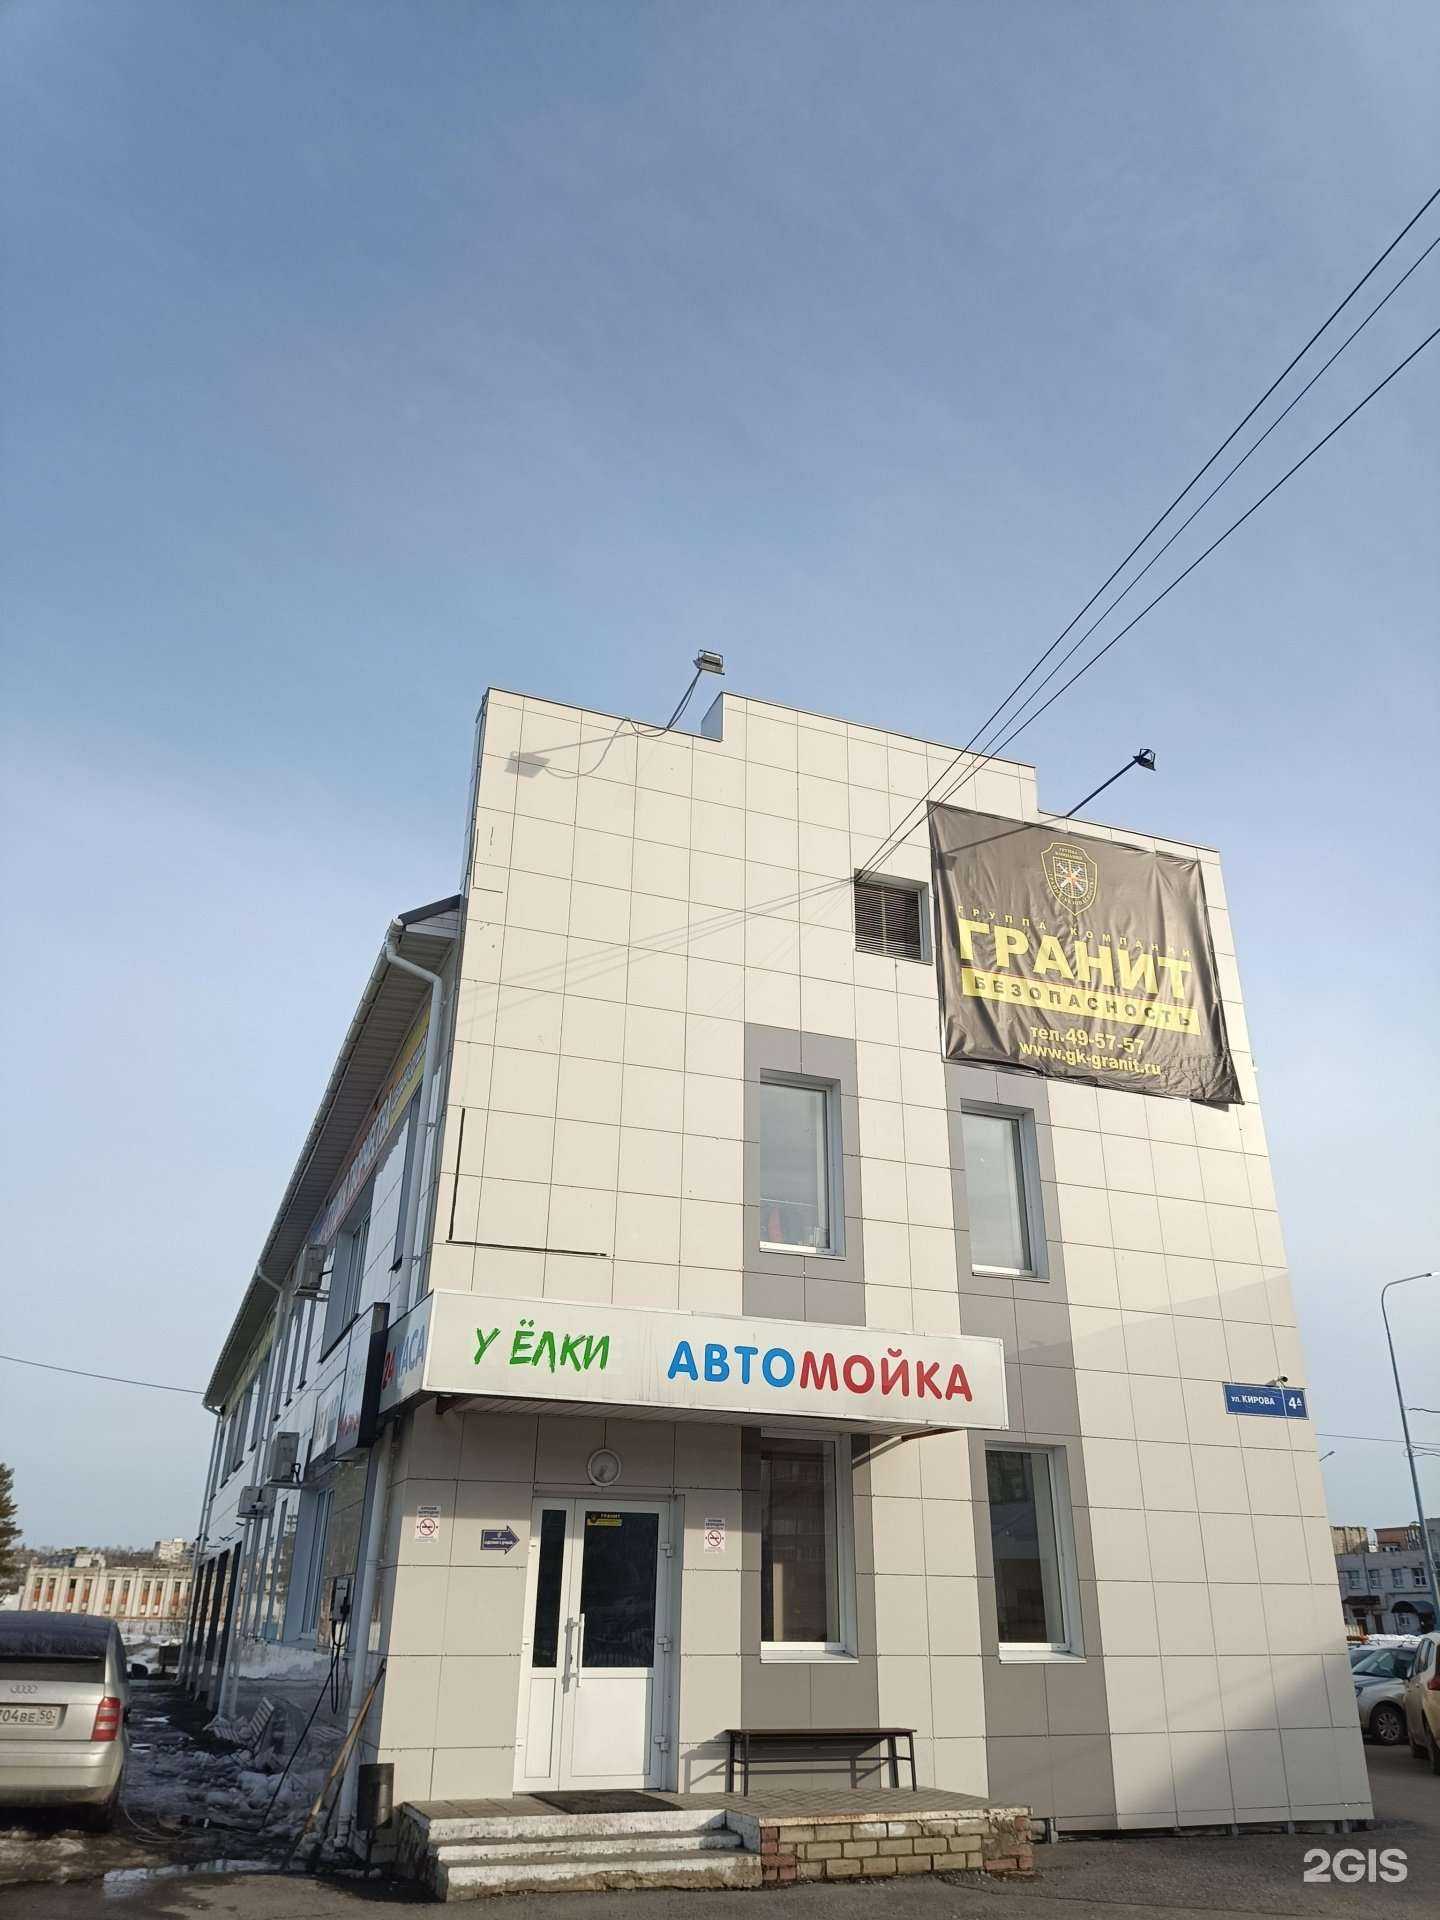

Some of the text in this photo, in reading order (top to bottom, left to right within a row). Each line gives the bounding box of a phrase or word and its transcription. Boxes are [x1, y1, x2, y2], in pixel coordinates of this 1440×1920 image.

[957, 905, 1047, 930] ГРУППА
[958, 917, 1192, 1000] ГРАНИТ
[974, 976, 1190, 1026] БЕЗОПАСНОСТЬ
[1019, 1041, 1162, 1075] www.gk-granit.ru
[474, 1319, 610, 1373] У ЁЛКИ
[667, 1340, 973, 1402] АВТОМОЙКА
[1241, 1394, 1276, 1406] КИРОВА
